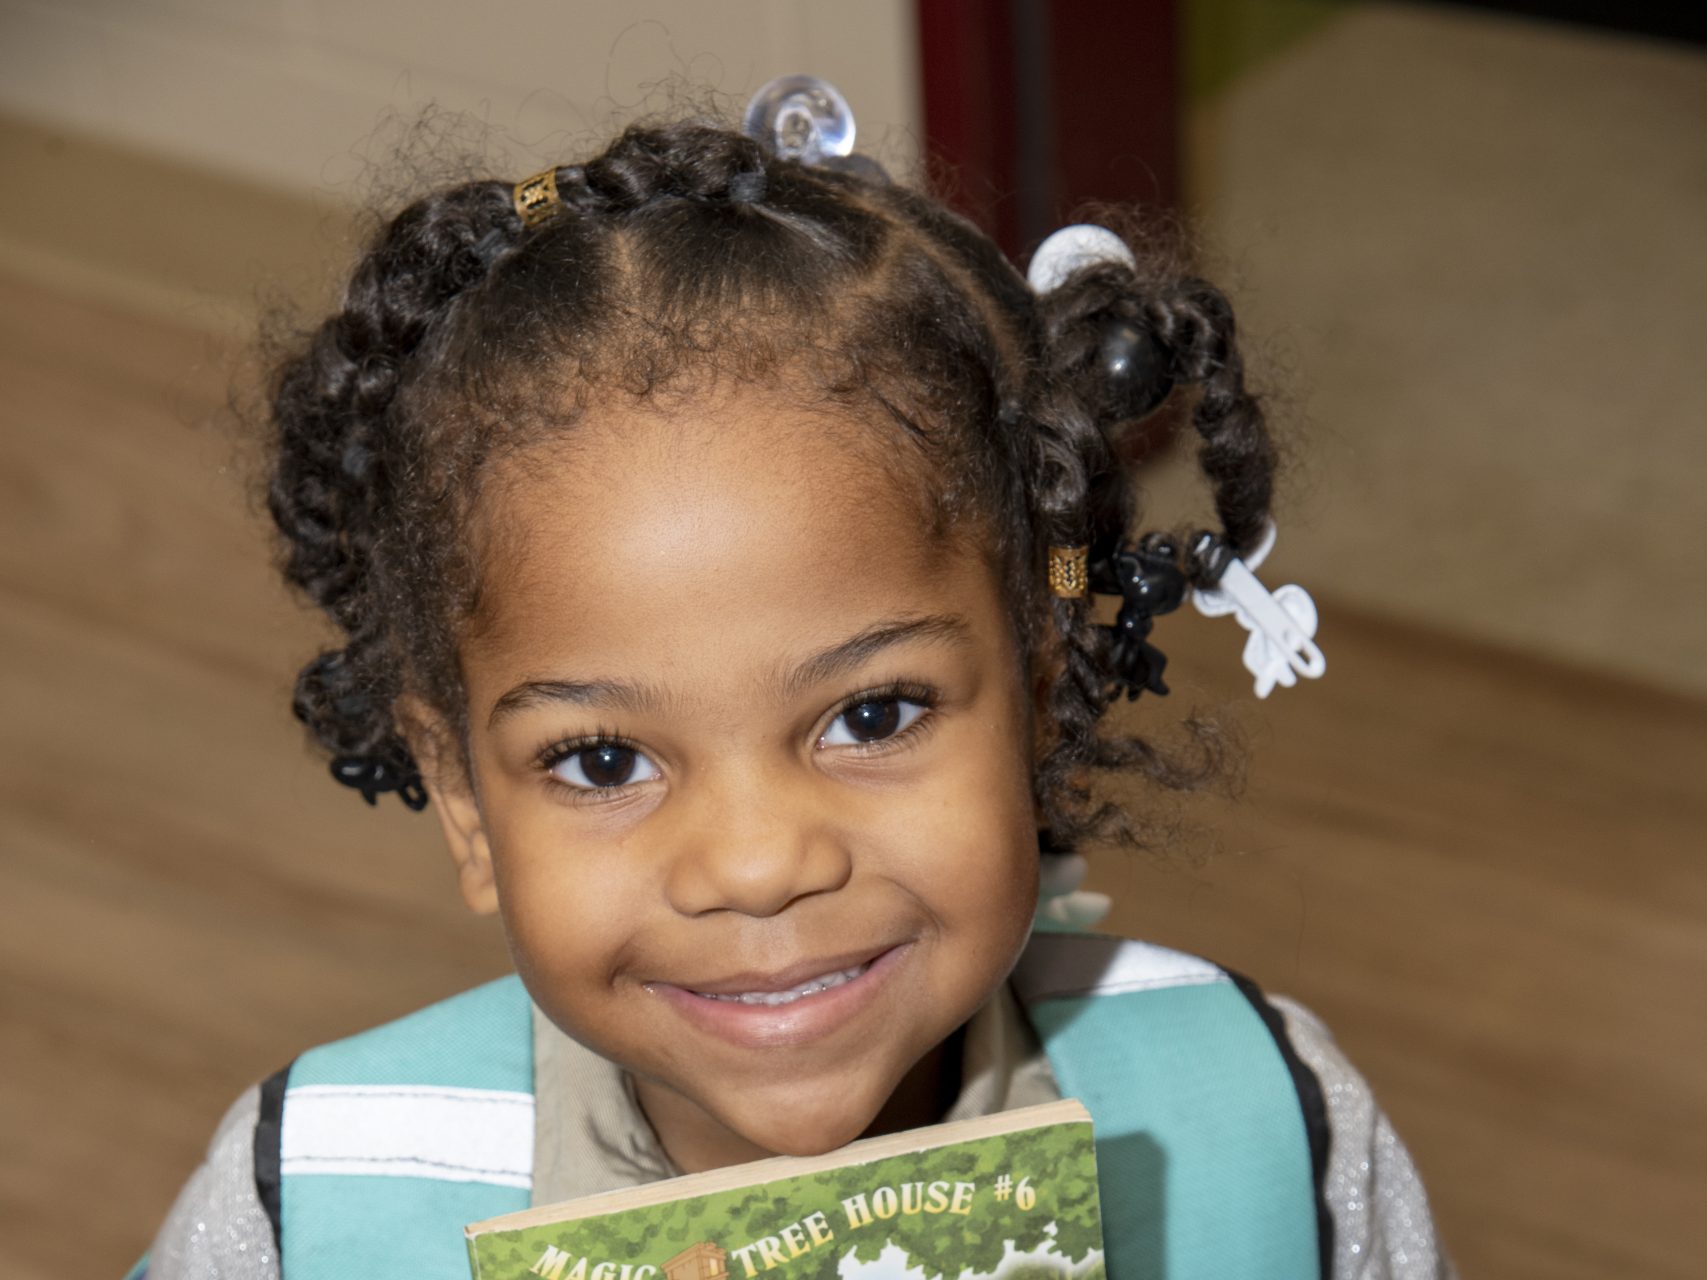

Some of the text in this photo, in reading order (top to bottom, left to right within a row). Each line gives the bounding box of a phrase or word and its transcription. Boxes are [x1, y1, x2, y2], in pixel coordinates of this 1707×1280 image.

[731, 1211, 834, 1279] TREE
[841, 1181, 976, 1231] HOUSE
[994, 1174, 1036, 1211] #6
